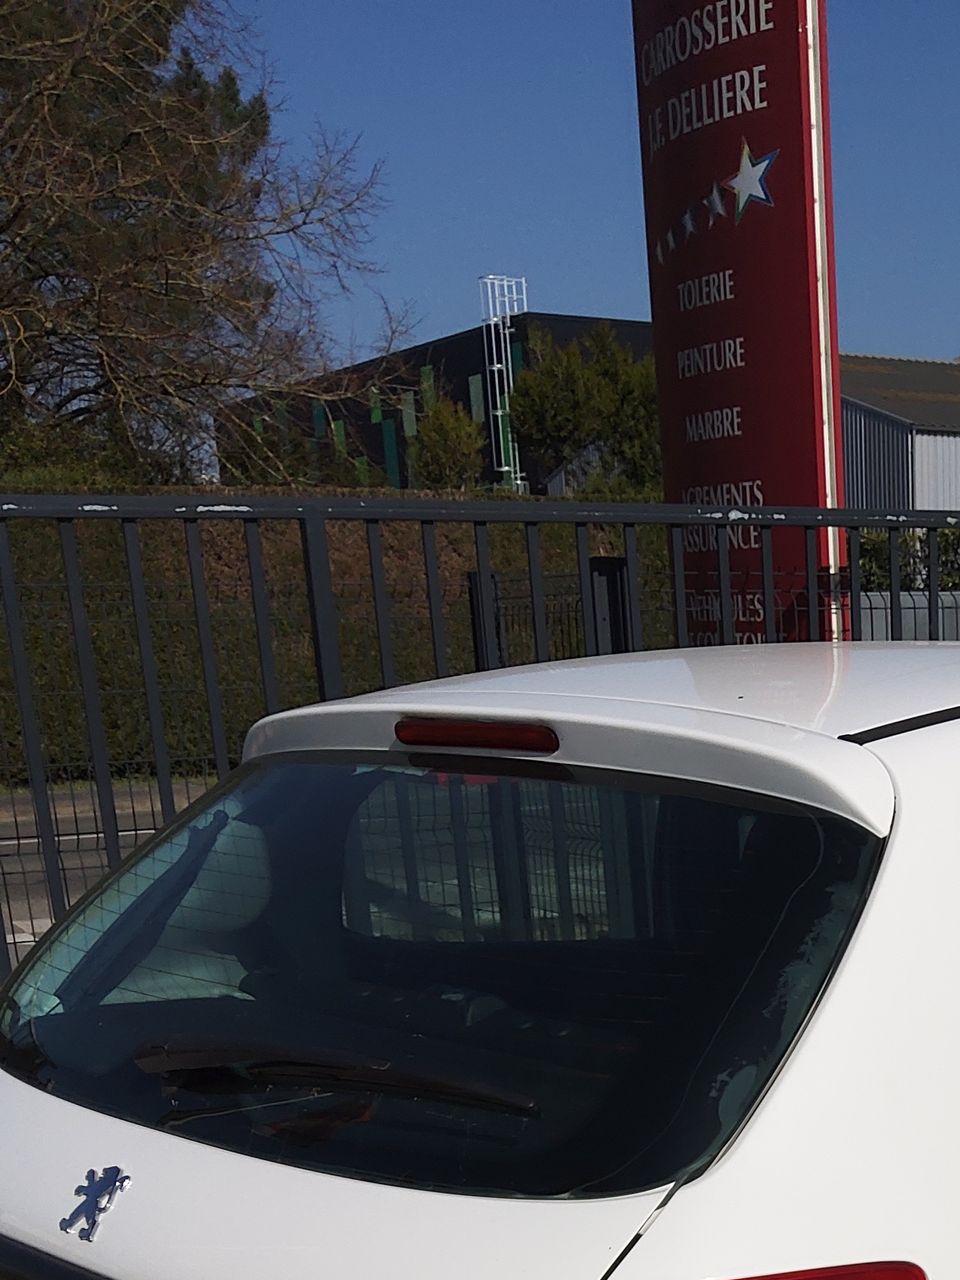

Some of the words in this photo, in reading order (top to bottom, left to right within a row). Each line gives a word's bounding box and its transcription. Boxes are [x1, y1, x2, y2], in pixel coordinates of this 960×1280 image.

[641, 0, 775, 86] CARROSSERIE
[668, 64, 768, 141] DELLIERE
[677, 269, 735, 312] TOLERIE
[677, 337, 745, 379] PEINTURE
[685, 406, 742, 443] MARBRE
[683, 524, 762, 553] ASSURNCE
